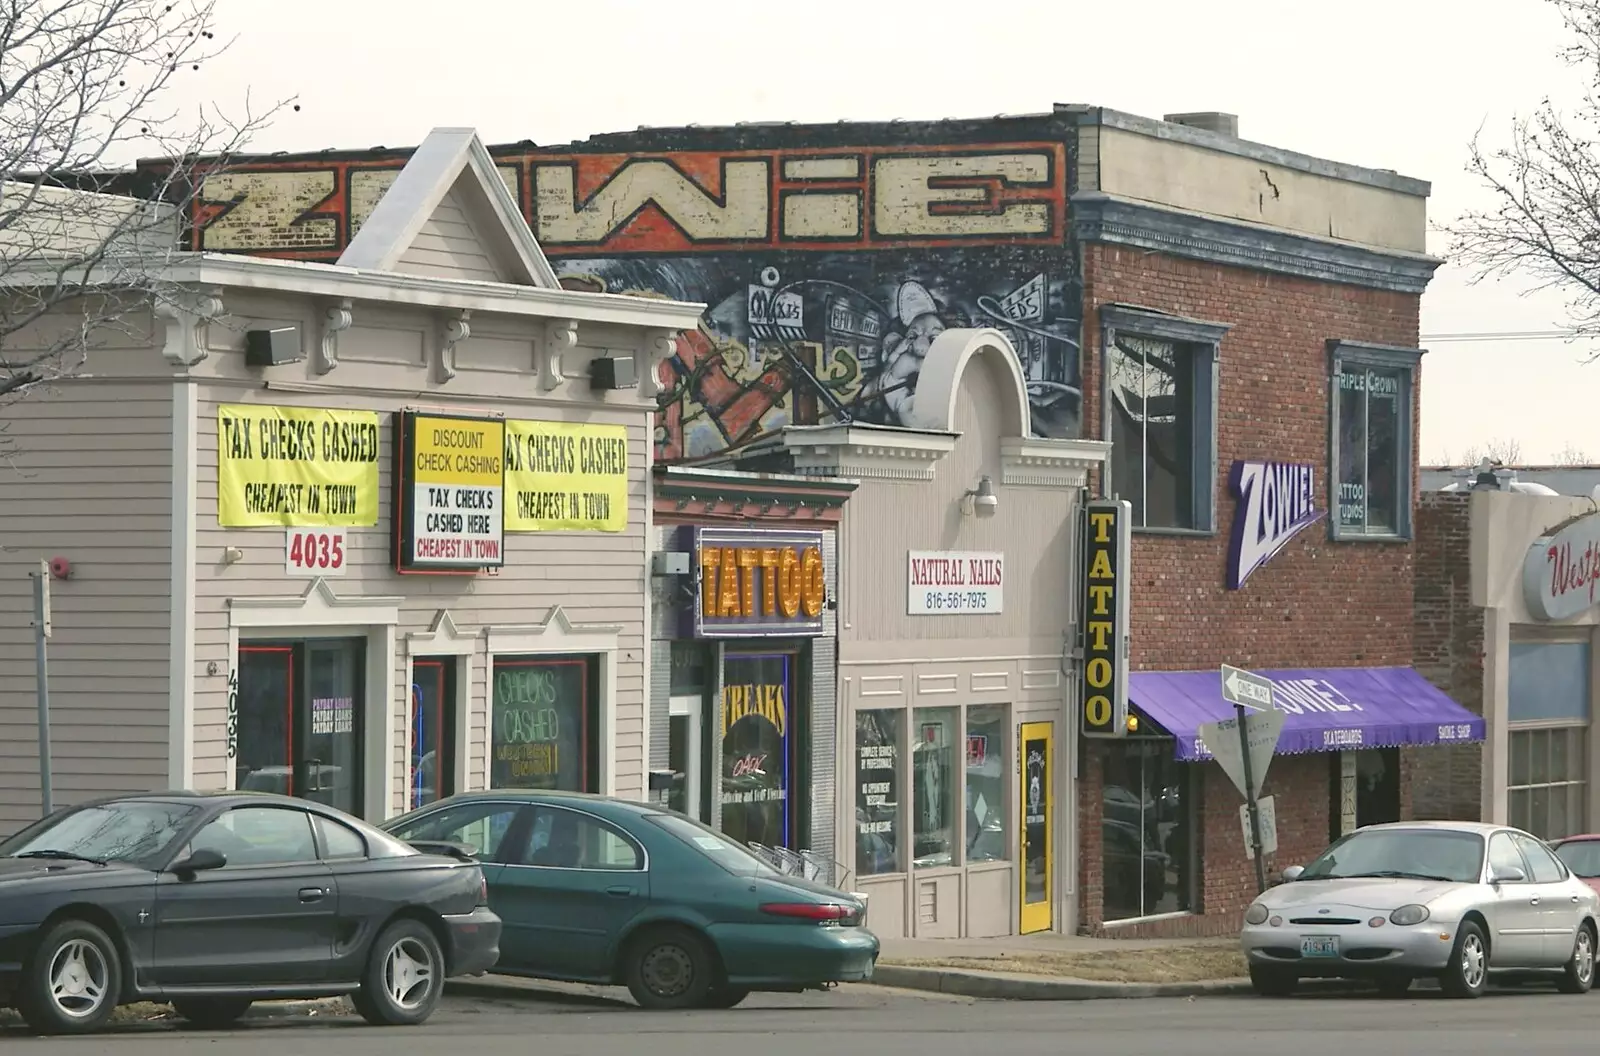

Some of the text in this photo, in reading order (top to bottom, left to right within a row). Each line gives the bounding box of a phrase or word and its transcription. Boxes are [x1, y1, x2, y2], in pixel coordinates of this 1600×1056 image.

[200, 153, 1050, 250] ZWIE
[1339, 372, 1365, 391] RIPLE
[223, 418, 377, 462] TAX CHECKS CASHED
[433, 429, 484, 449] DISCOUNT
[417, 452, 500, 474] CHECK CASHING
[505, 434, 625, 475] AX CHECKS CASHED
[245, 483, 356, 514] CHEAPEST IN TOWN
[429, 488, 493, 509] TAX CHECKS
[1338, 483, 1363, 499] ATTOO
[517, 491, 609, 520] CHEAPEST IN TOWN
[1339, 504, 1364, 520] TUDIOS
[427, 513, 490, 534] CASHED HERE
[1238, 462, 1315, 585] ZOWIE!
[290, 533, 343, 568] 4035
[417, 539, 499, 559] CHEAPEST IN TOWN
[698, 546, 825, 618] TATTOO
[912, 558, 1001, 585] NATURAL NAILS
[1548, 540, 1600, 604] Westp
[926, 592, 986, 609] 816-561-7975
[1086, 513, 1114, 726] TATTOO
[498, 671, 556, 705] CHECKS
[1238, 680, 1270, 703] ONE WAY
[228, 669, 238, 758] 4035
[721, 684, 785, 740] FREAKS
[1323, 729, 1362, 745] SKATEBOARDS
[1458, 724, 1471, 739] SHOP
